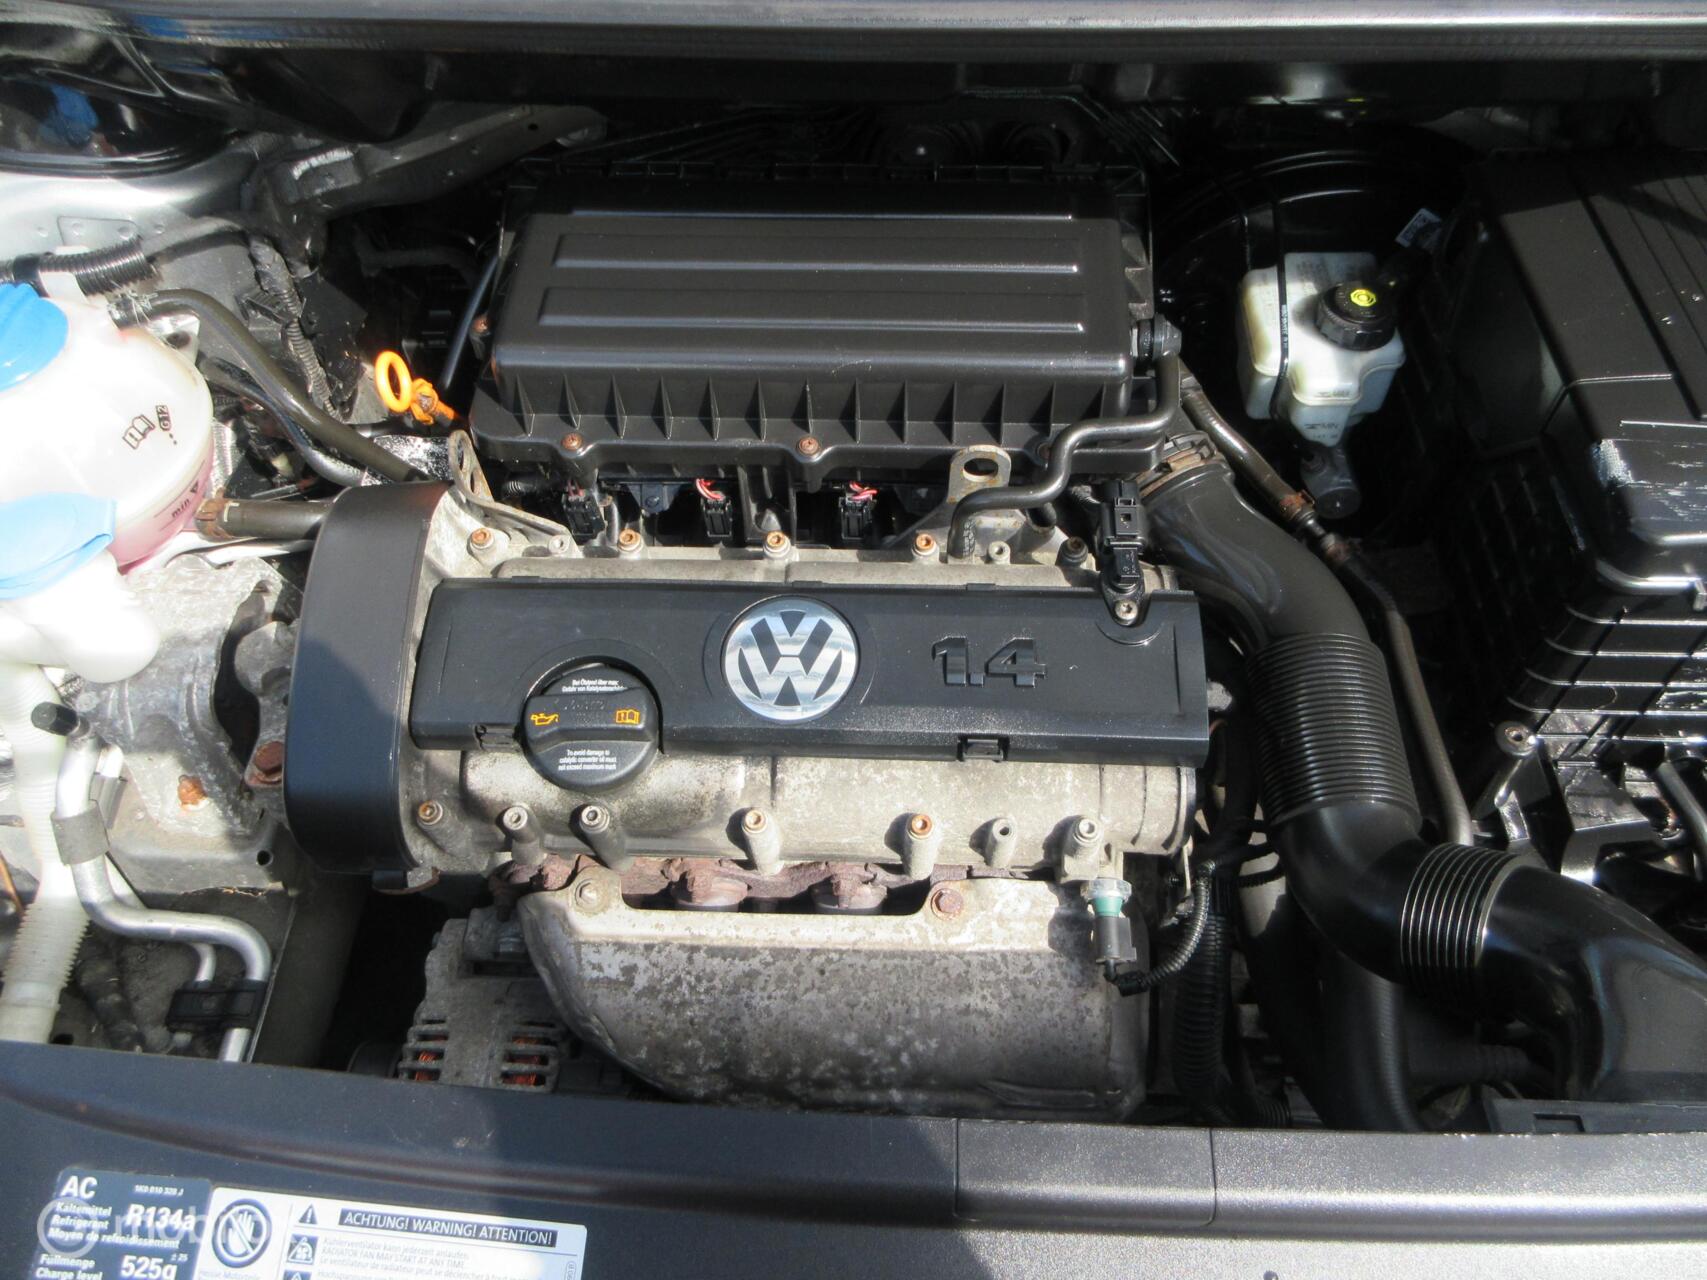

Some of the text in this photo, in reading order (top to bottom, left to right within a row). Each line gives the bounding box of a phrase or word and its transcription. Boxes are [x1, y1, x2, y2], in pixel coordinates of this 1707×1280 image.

[155, 405, 171, 431] G12
[171, 498, 190, 518] min
[725, 598, 857, 723] VW
[931, 634, 1047, 688] 1.4
[60, 1175, 98, 1200] AC
[50, 1214, 110, 1230] Refrigerant
[125, 1203, 195, 1232] R134a
[344, 1212, 553, 1245] ACHTUNG! WARNING! ATTENTION!
[47, 1227, 180, 1248] Moyen de refroidissement
[119, 1254, 178, 1280] 525g
